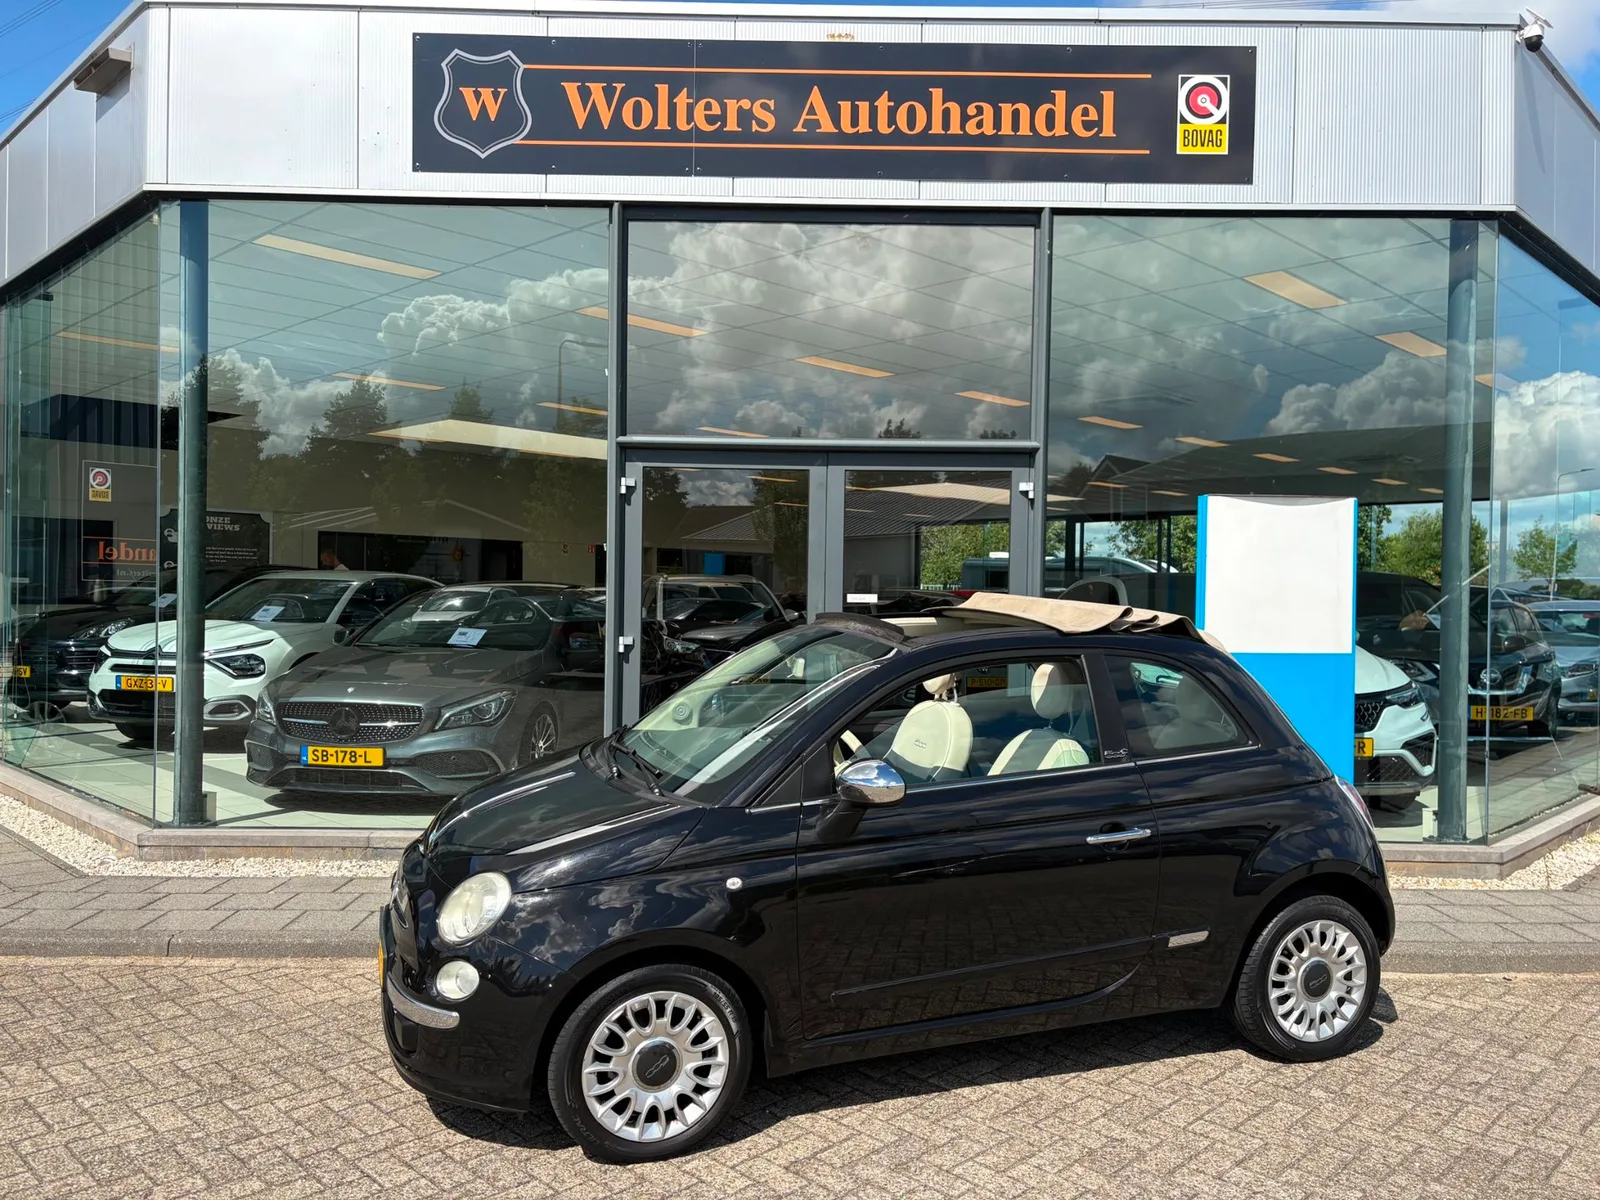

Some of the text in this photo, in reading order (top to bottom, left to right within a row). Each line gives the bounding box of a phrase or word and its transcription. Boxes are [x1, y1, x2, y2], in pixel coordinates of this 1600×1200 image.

[459, 87, 508, 122] W
[561, 82, 1117, 139] Wolters Autohandel
[1182, 128, 1223, 148] BOVAG
[206, 523, 241, 532] VIEWS
[126, 678, 167, 689] GXZ-3-V
[311, 749, 372, 764] SB-178-L
